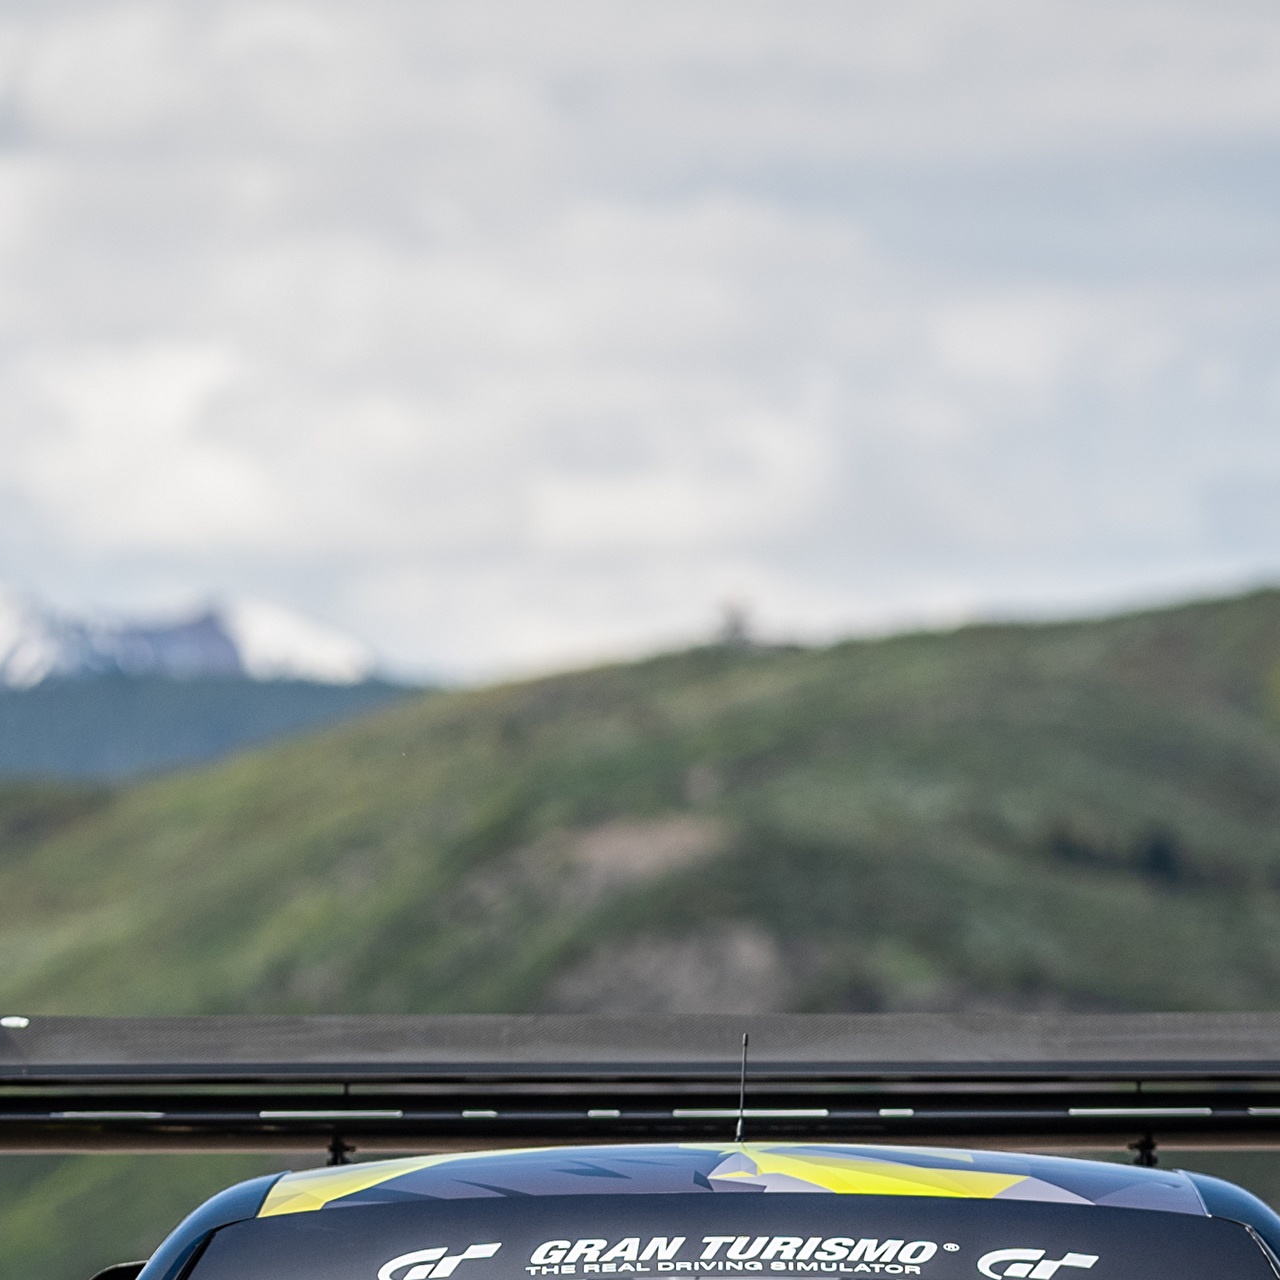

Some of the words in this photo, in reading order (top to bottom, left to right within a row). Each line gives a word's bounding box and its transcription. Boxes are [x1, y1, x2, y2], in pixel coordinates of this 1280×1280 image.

[530, 1236, 687, 1265] GRAN
[524, 1264, 577, 1276] THE
[583, 1262, 651, 1274] REAL
[657, 1260, 763, 1272] DRIVING
[770, 1261, 921, 1275] SIMULATOR
